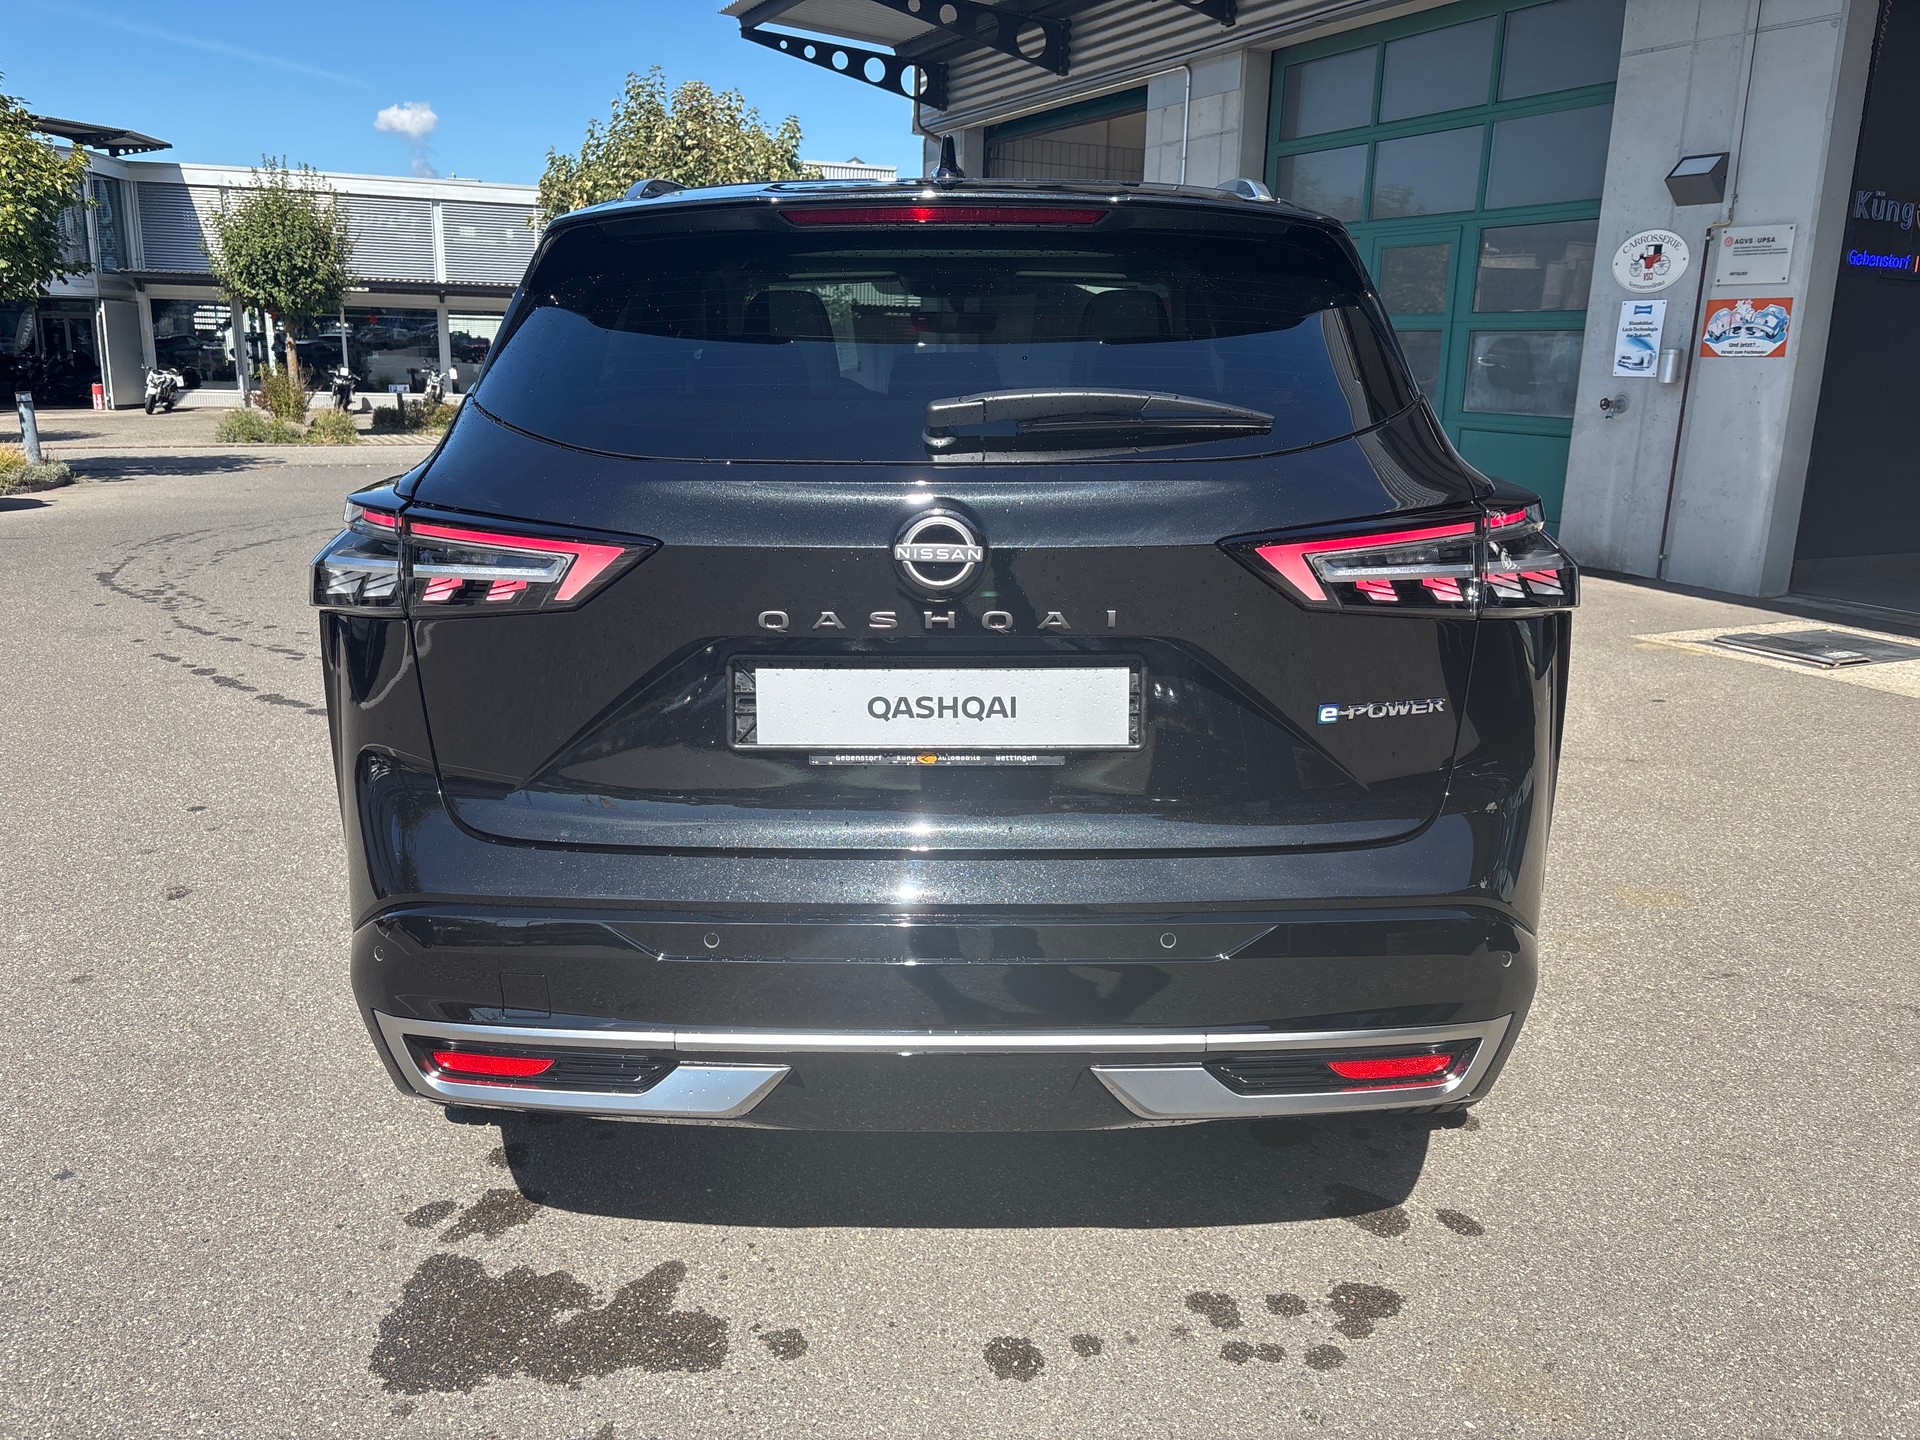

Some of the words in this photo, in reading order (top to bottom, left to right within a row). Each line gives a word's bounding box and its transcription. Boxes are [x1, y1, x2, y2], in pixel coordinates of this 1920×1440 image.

[1853, 190, 1915, 230] Küng
[1622, 233, 1683, 254] CARROSSERIE
[1734, 237, 1754, 245] AGVS
[1757, 236, 1776, 244] UPSA
[1848, 249, 1911, 269] Gebenstorf
[896, 546, 982, 560] NISSAN
[758, 610, 1117, 633] QASHQAI
[867, 695, 1017, 722] QASHQAI
[1319, 697, 1446, 722] e-POWER
[995, 754, 1037, 763] Wettingen
